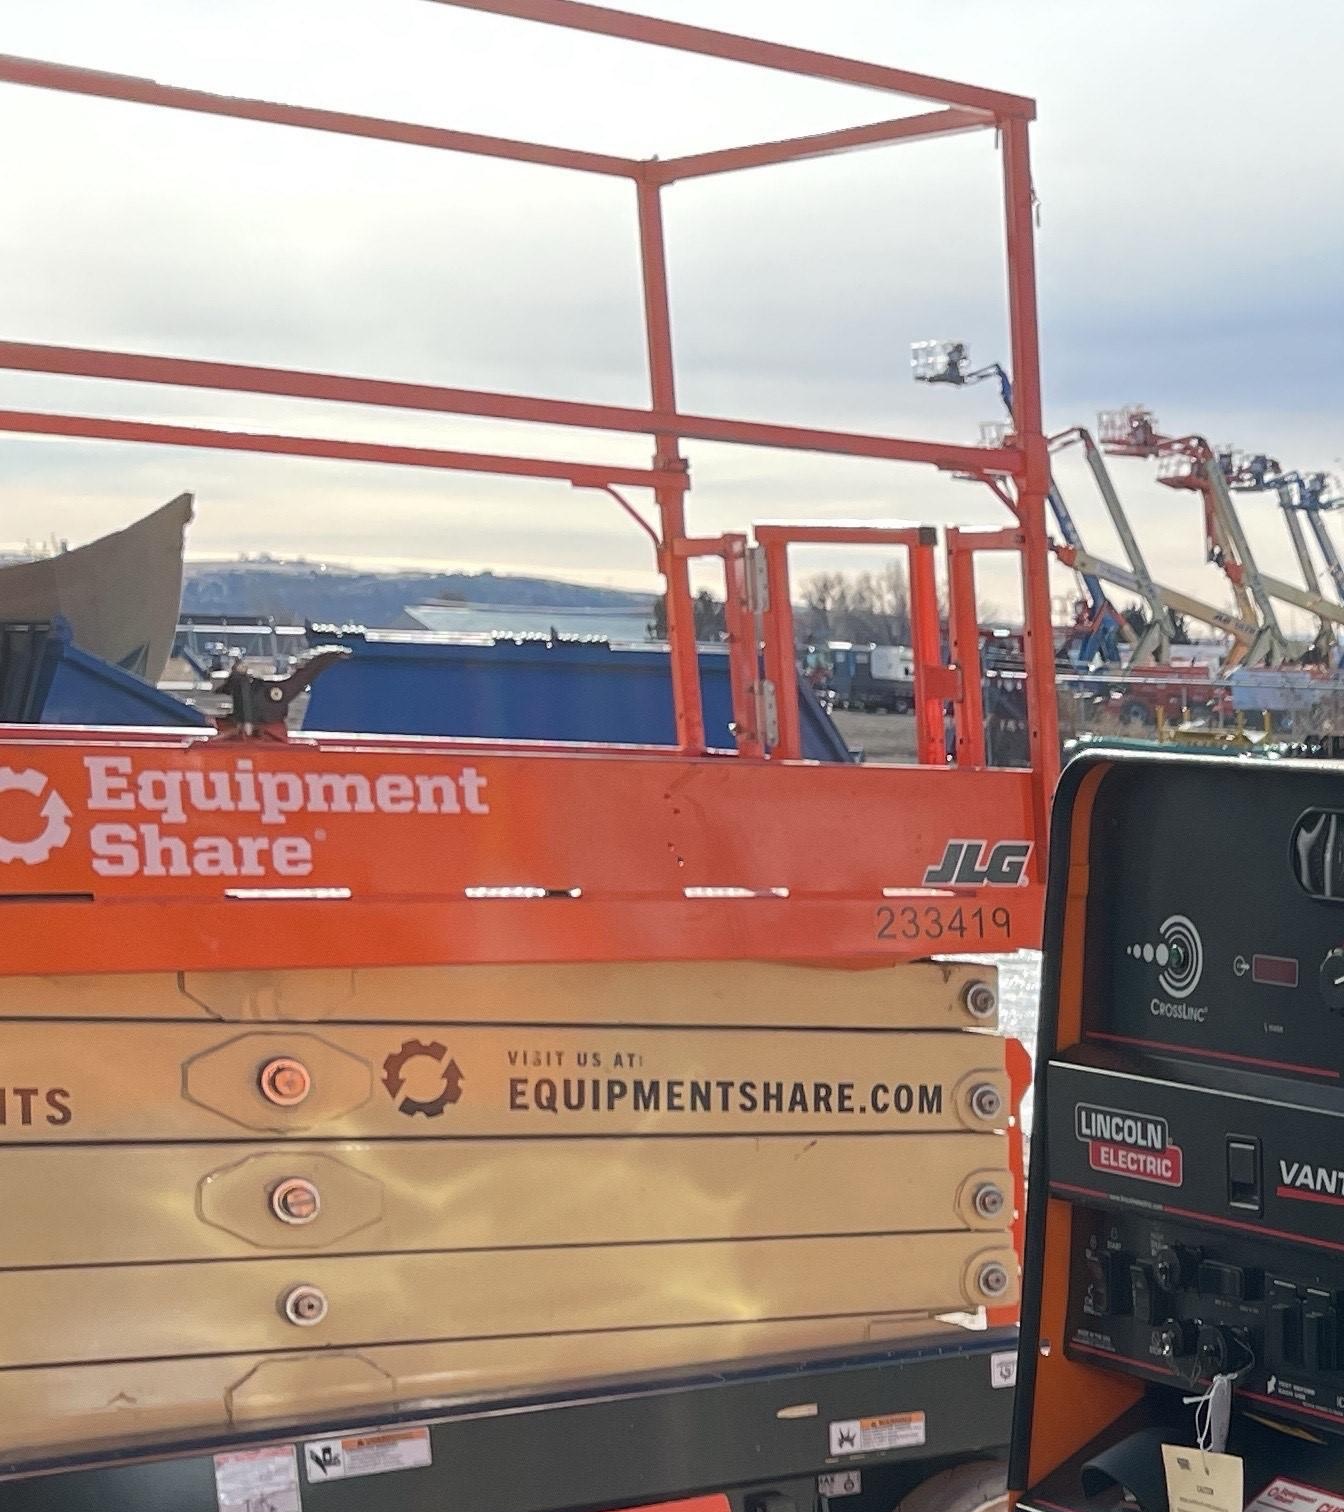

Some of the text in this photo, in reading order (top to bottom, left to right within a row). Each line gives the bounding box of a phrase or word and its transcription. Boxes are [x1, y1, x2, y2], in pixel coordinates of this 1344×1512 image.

[84, 755, 490, 823] Equipment
[90, 823, 313, 877] Share
[923, 840, 1032, 886] JLG
[876, 906, 1011, 939] 233419
[507, 1050, 565, 1067] VISIT
[577, 1052, 601, 1067] US
[0, 1086, 72, 1127] TS
[509, 1077, 943, 1115] EQUIPMENTSHARE.COM
[1081, 1110, 1161, 1149] LINCOLN
[1100, 1146, 1172, 1178] ELECTRIC
